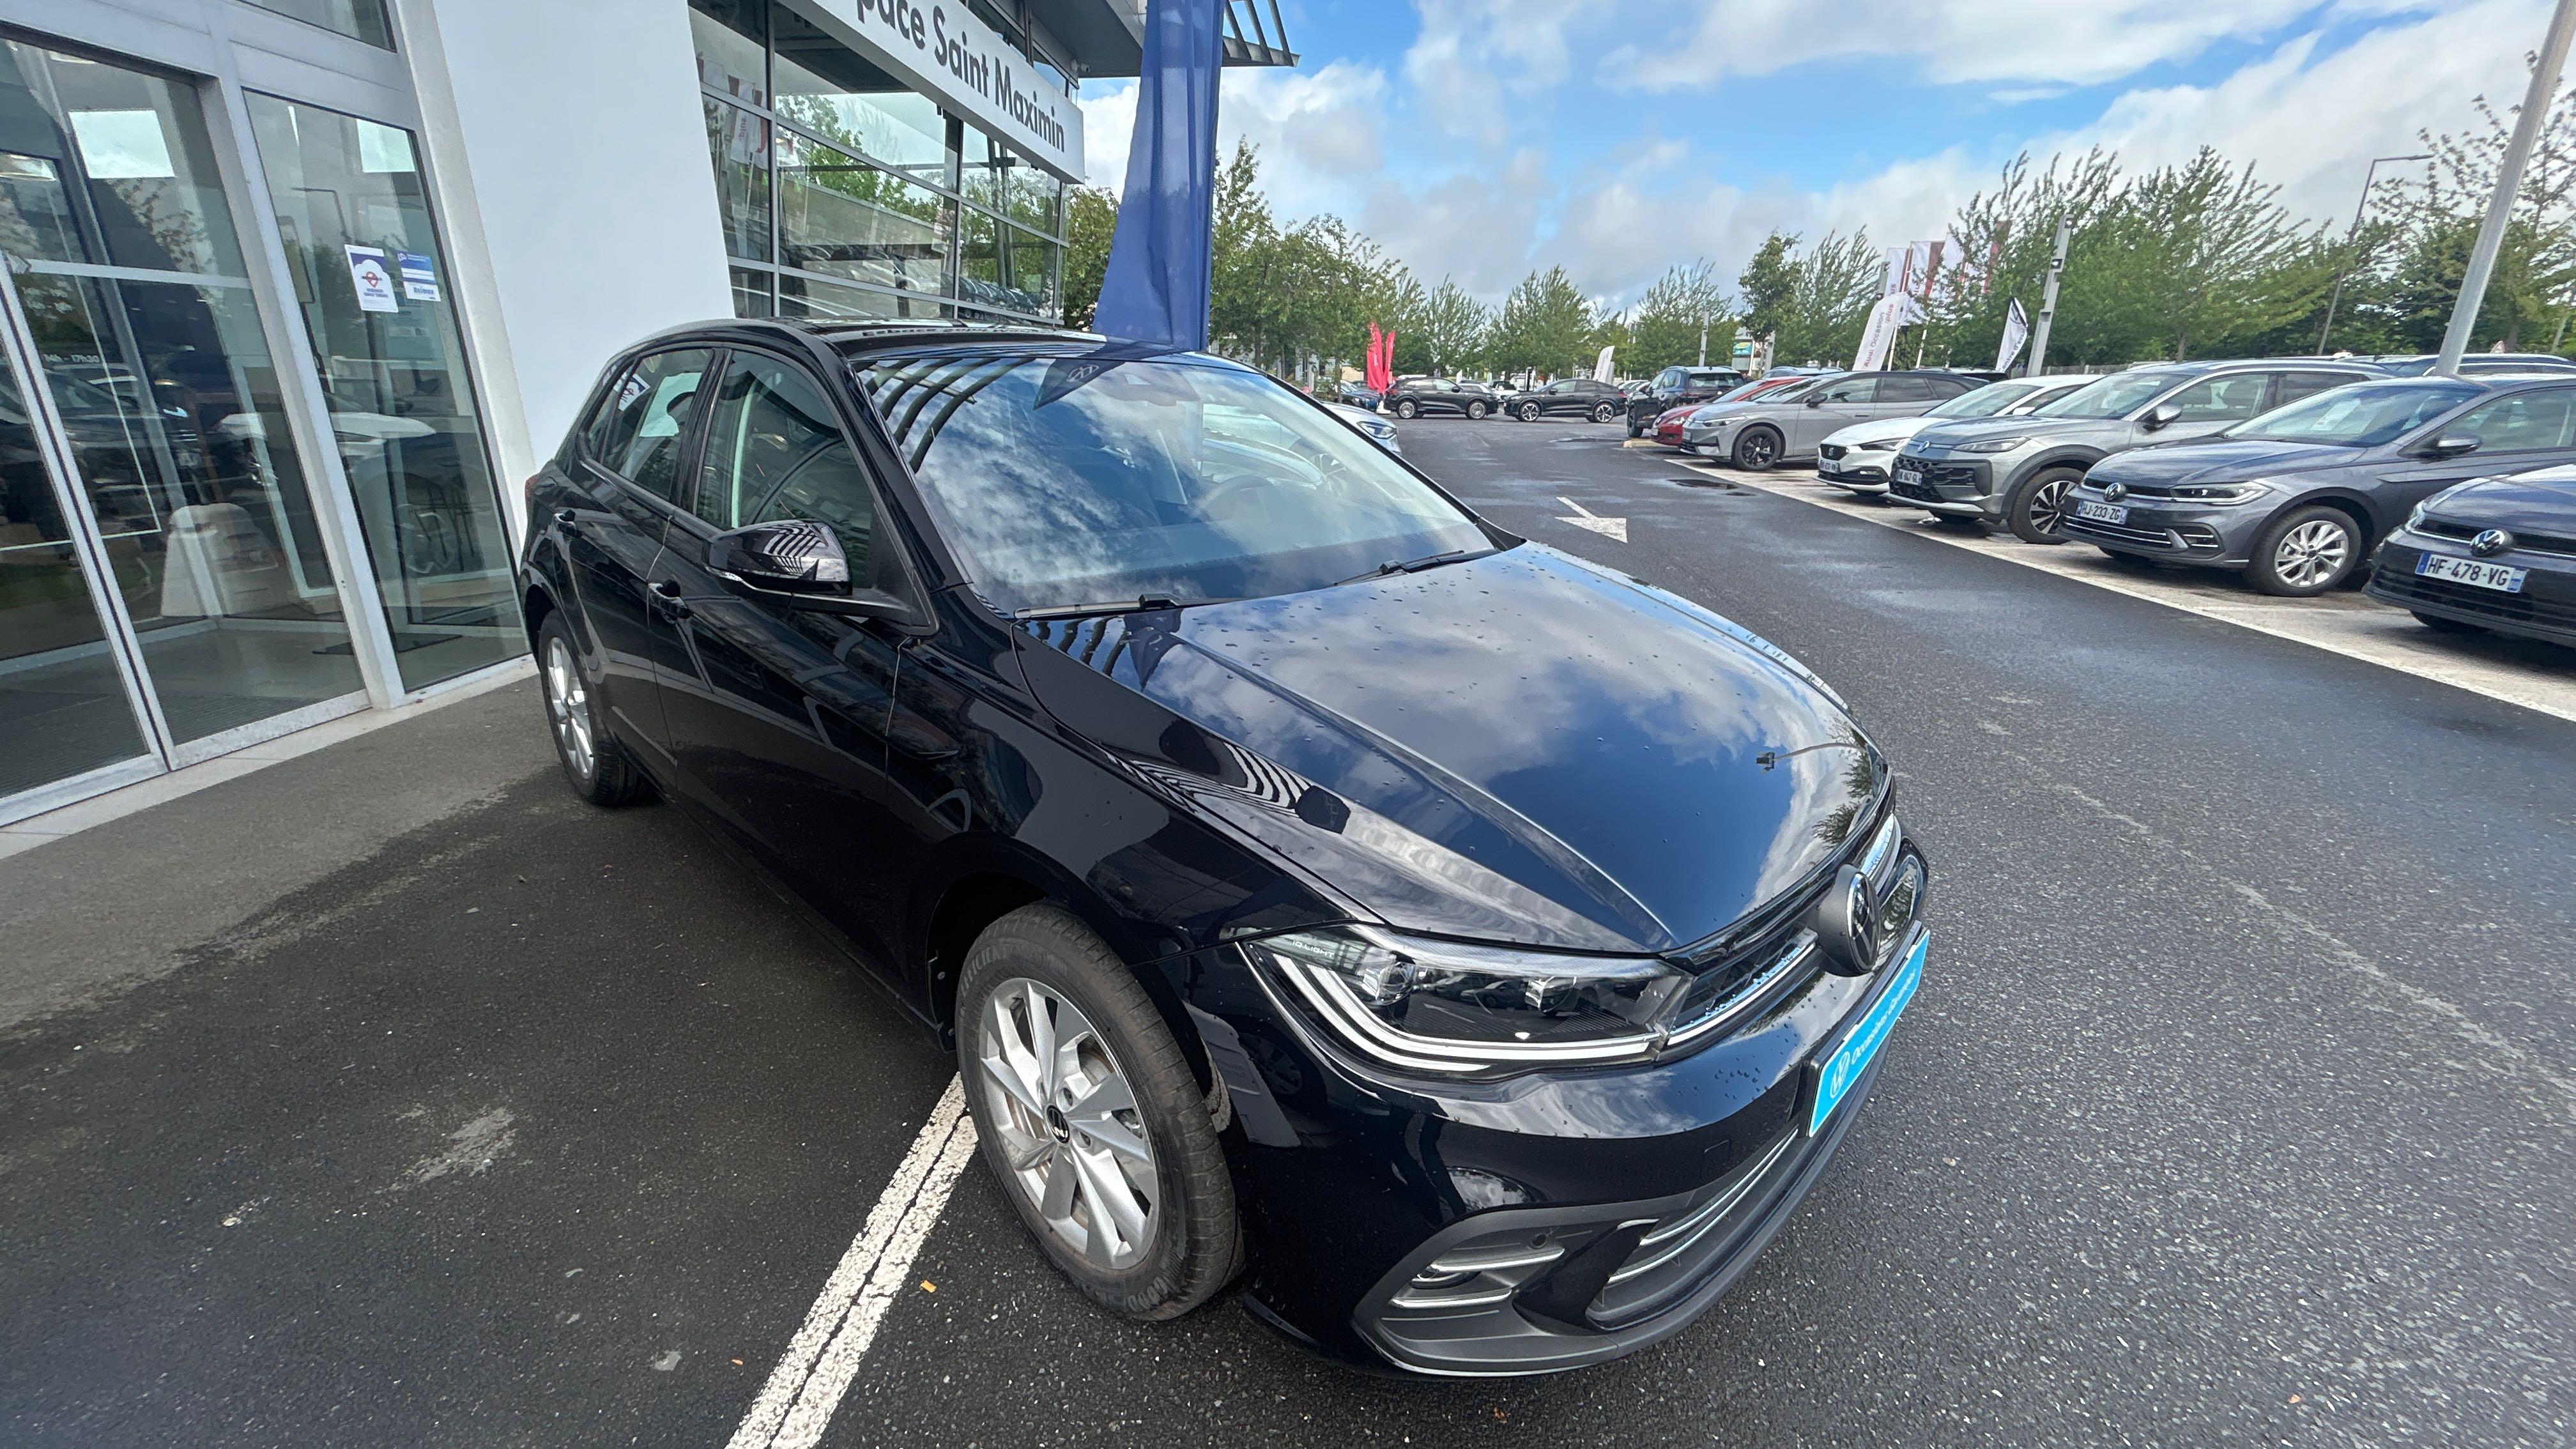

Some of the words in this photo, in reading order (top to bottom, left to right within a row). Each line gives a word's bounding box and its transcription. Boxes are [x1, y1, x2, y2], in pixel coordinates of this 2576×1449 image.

[933, 5, 988, 98] Saint
[995, 56, 1065, 153] Maximin
[1864, 349, 1874, 367] Audi
[1871, 312, 1885, 348] Occasion
[2427, 557, 2510, 586] HF-478-VG
